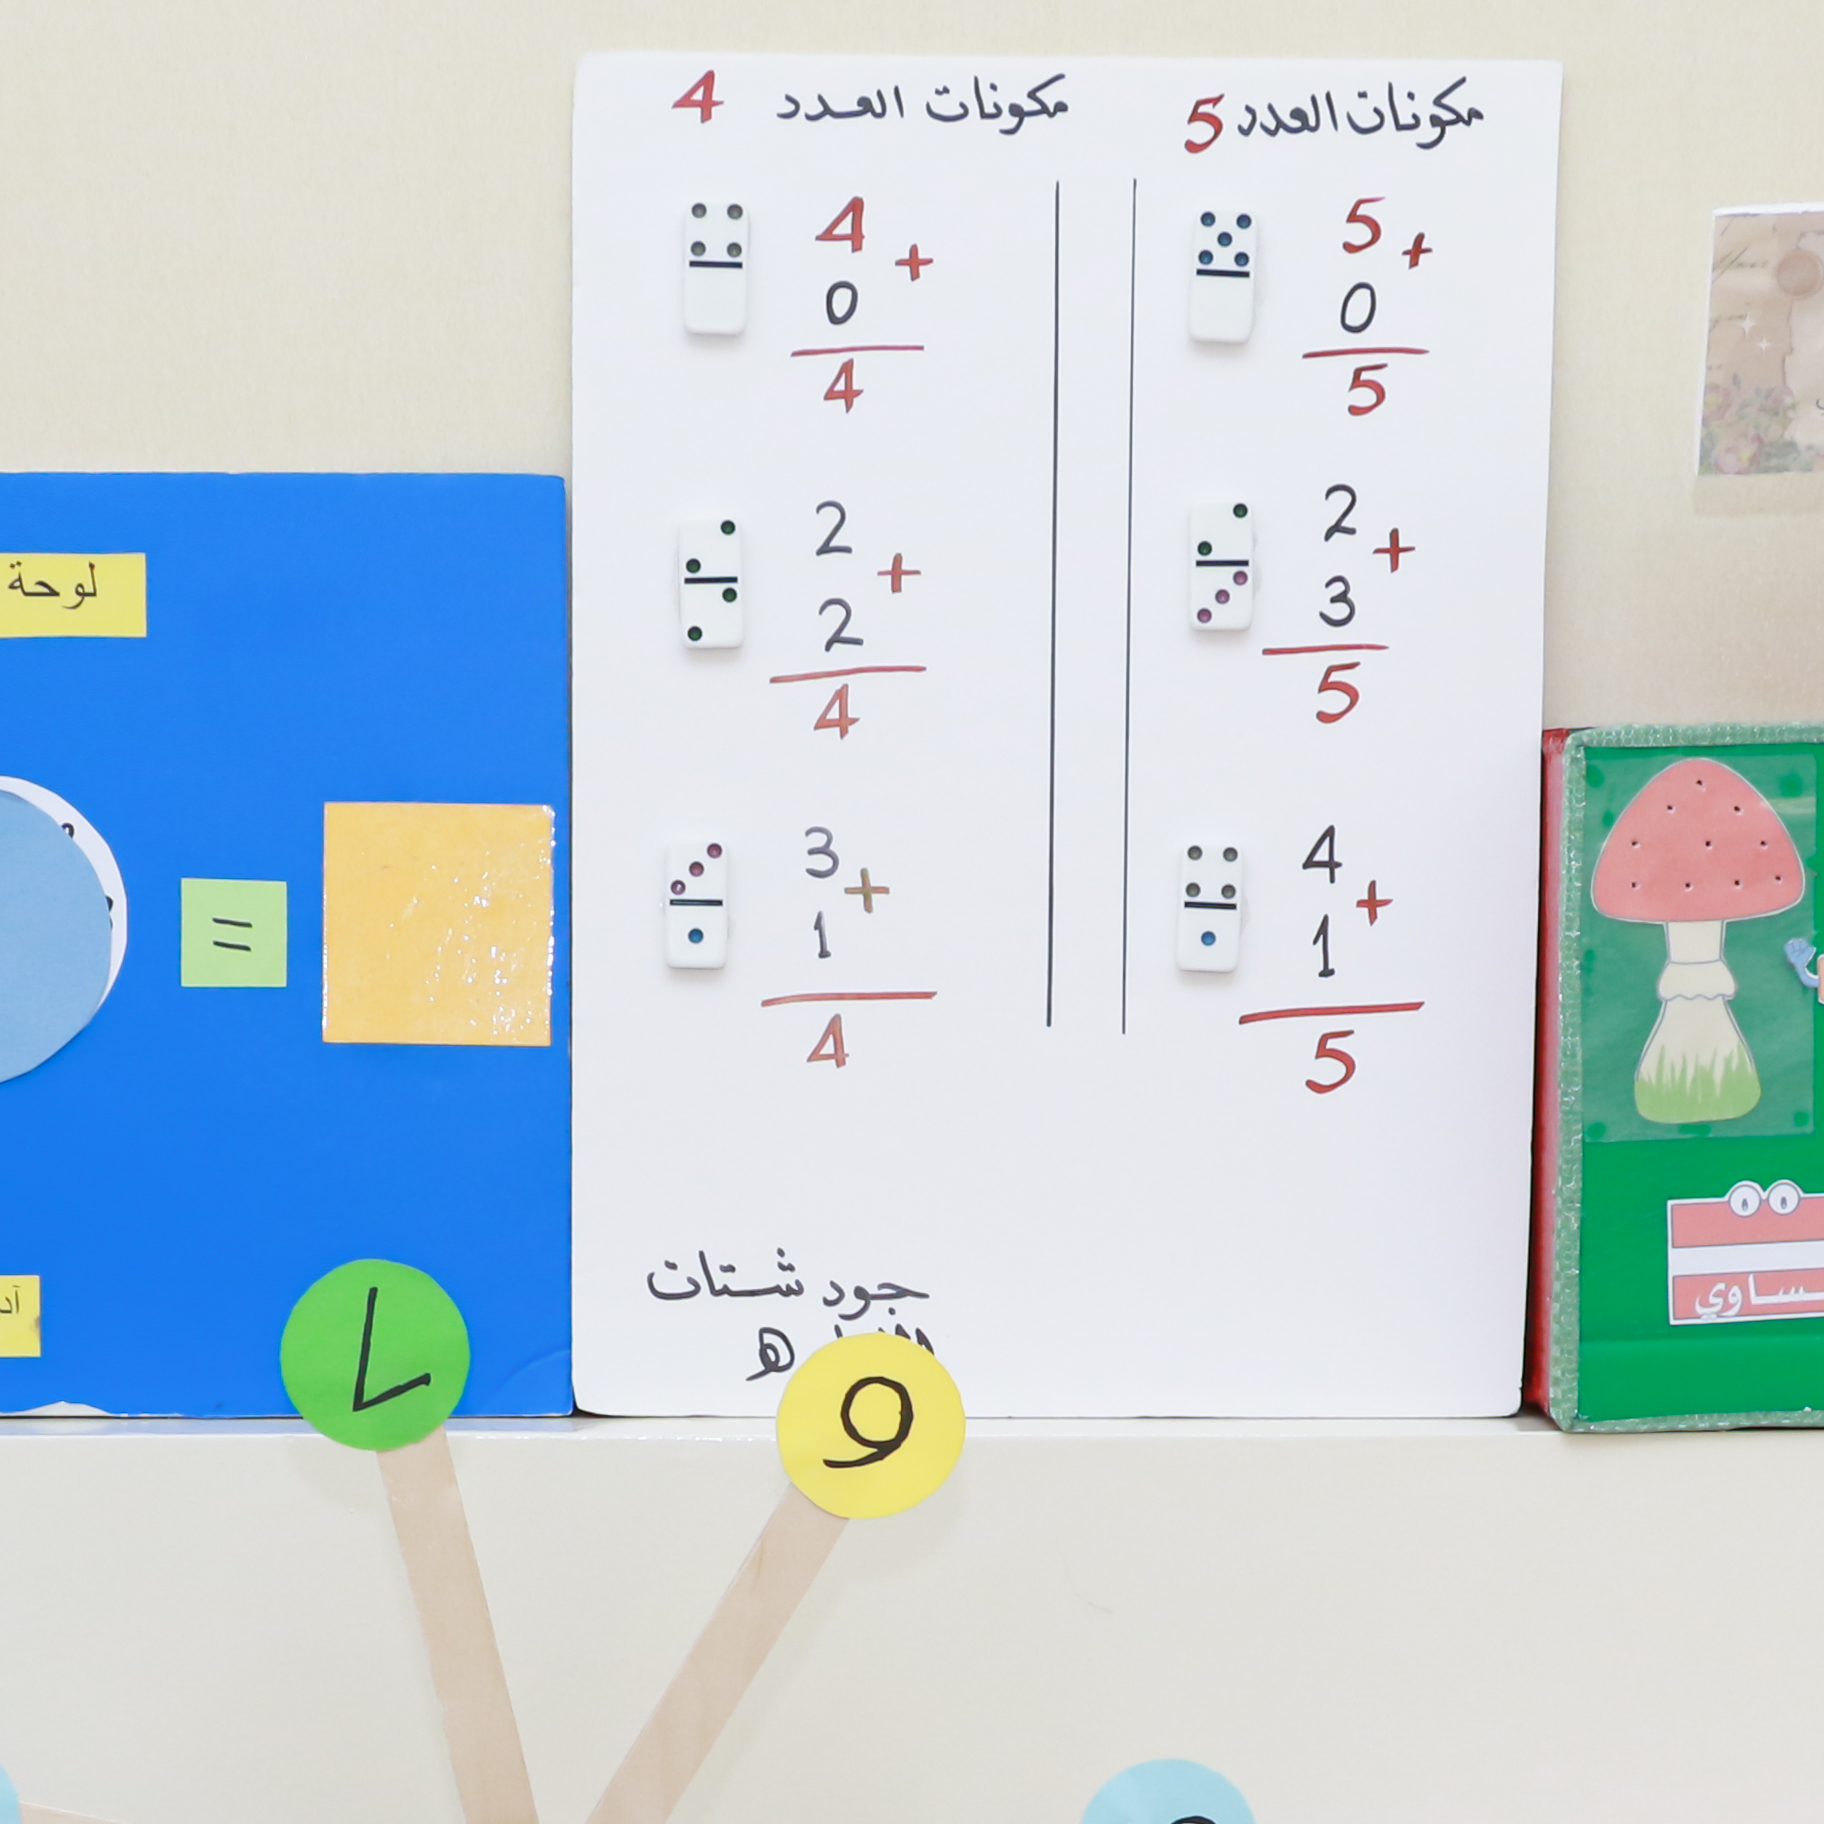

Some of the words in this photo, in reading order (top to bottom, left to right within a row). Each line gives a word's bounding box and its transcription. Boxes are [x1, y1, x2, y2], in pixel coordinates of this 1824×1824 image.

[671, 69, 724, 124] 4
[777, 81, 905, 122] العدد
[925, 73, 1069, 136] مكونات
[1184, 94, 1224, 154] 5
[1237, 90, 1341, 137] العدد
[1347, 76, 1485, 148] مكونات
[815, 195, 866, 254] 4
[1342, 195, 1387, 254] 5
[825, 280, 859, 326] 0
[1340, 281, 1376, 334] 0
[823, 358, 865, 414] 4
[1347, 363, 1388, 417] 5
[7, 560, 99, 602] لوحة
